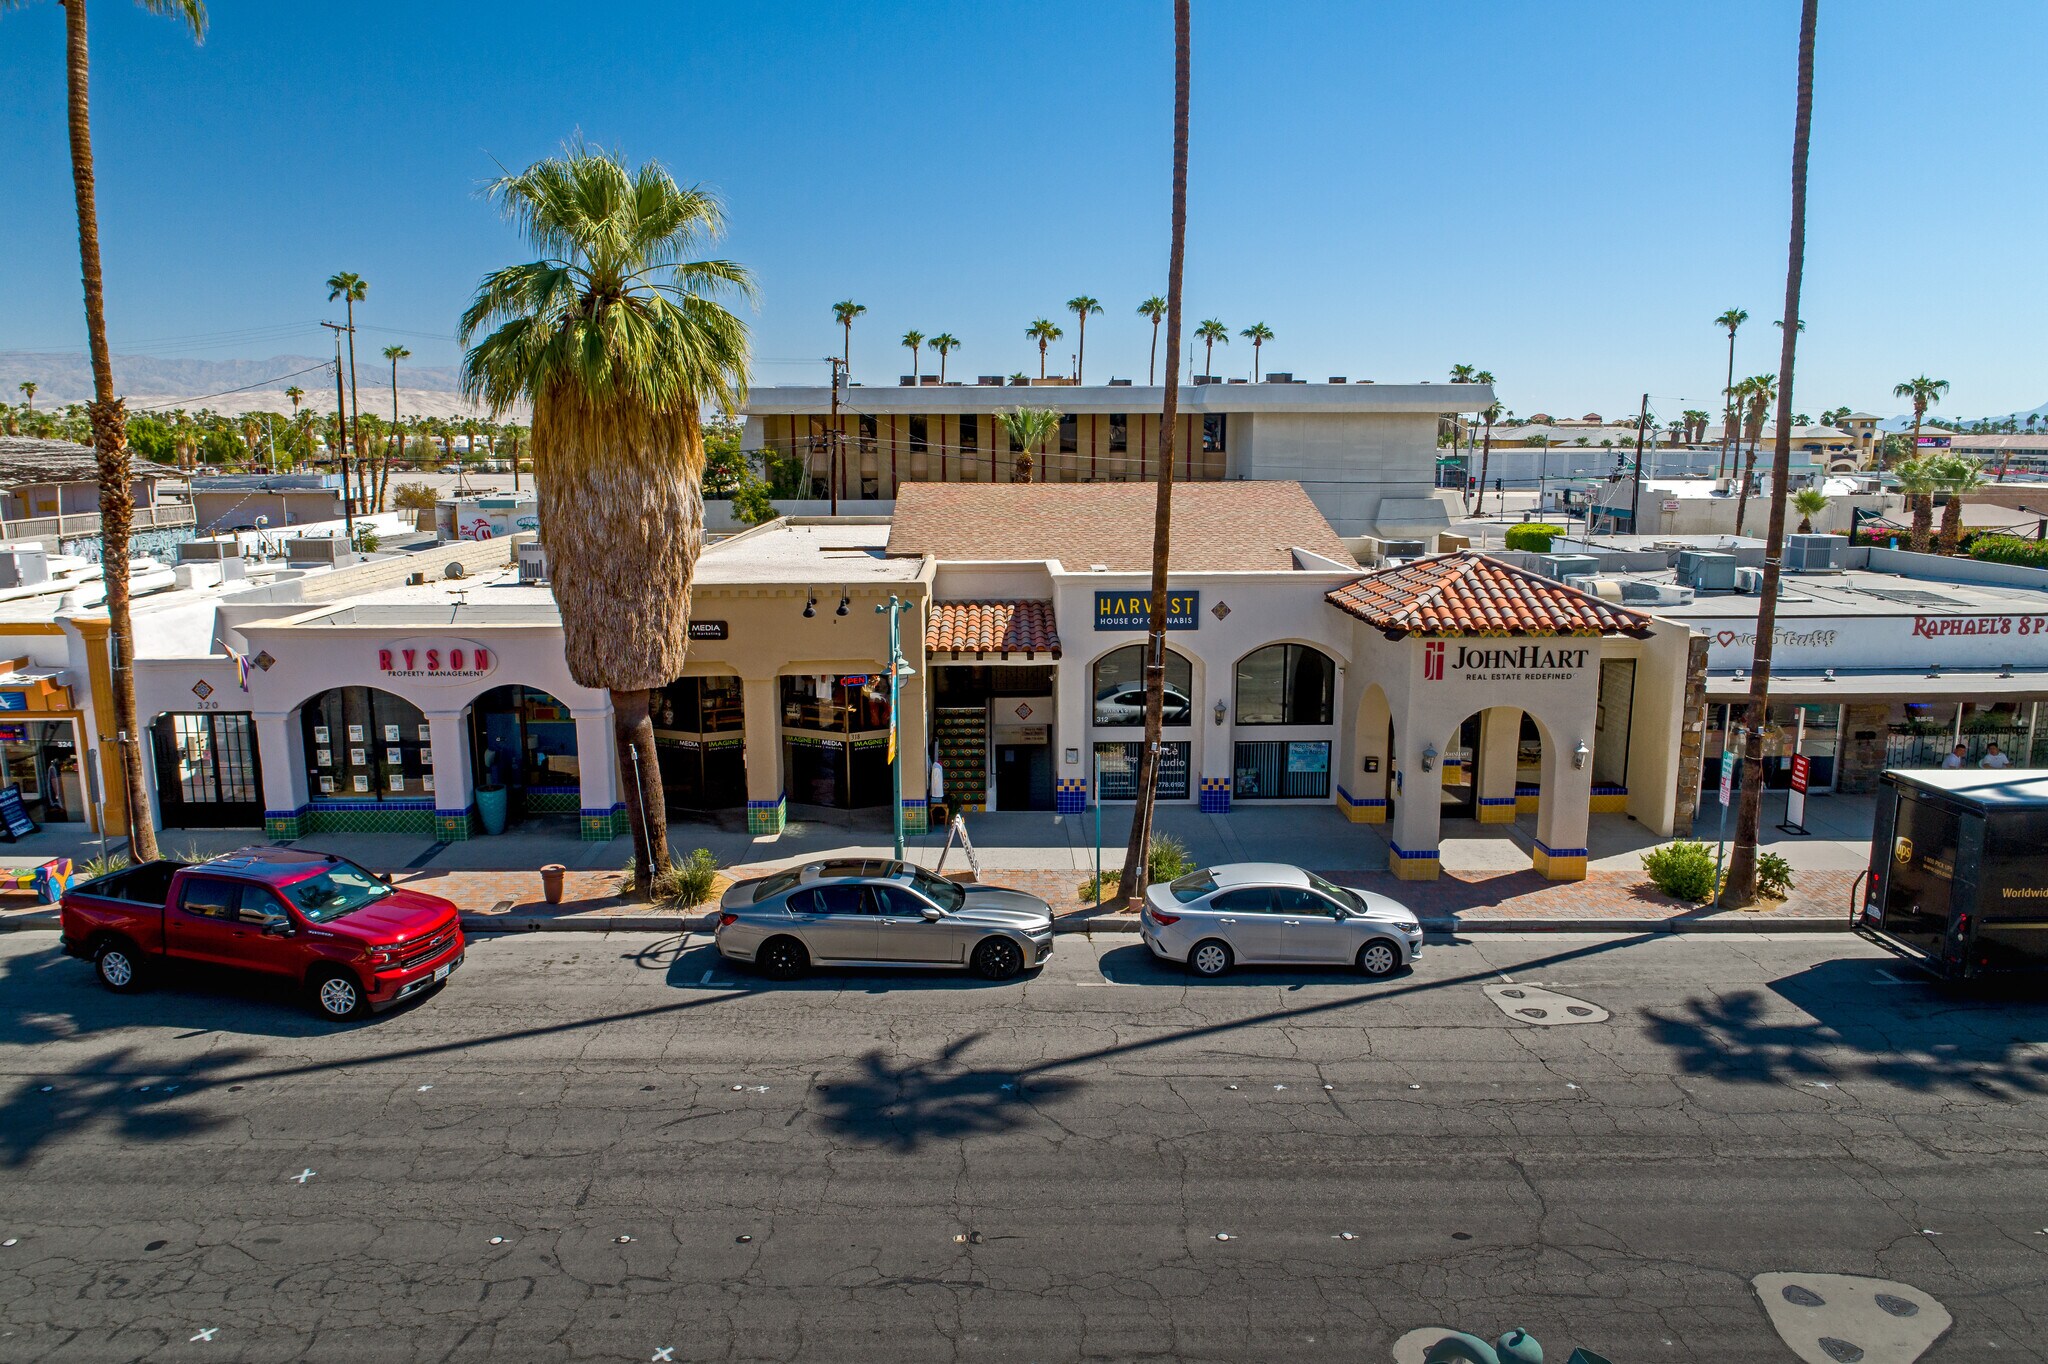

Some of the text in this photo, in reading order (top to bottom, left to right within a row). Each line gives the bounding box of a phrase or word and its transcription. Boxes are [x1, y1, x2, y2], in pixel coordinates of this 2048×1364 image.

[1100, 598, 1194, 615] HARVST
[378, 648, 488, 670] RYSON
[840, 677, 865, 686] OPEN
[1158, 758, 1186, 766] tudio
[1896, 844, 1911, 860] ups
